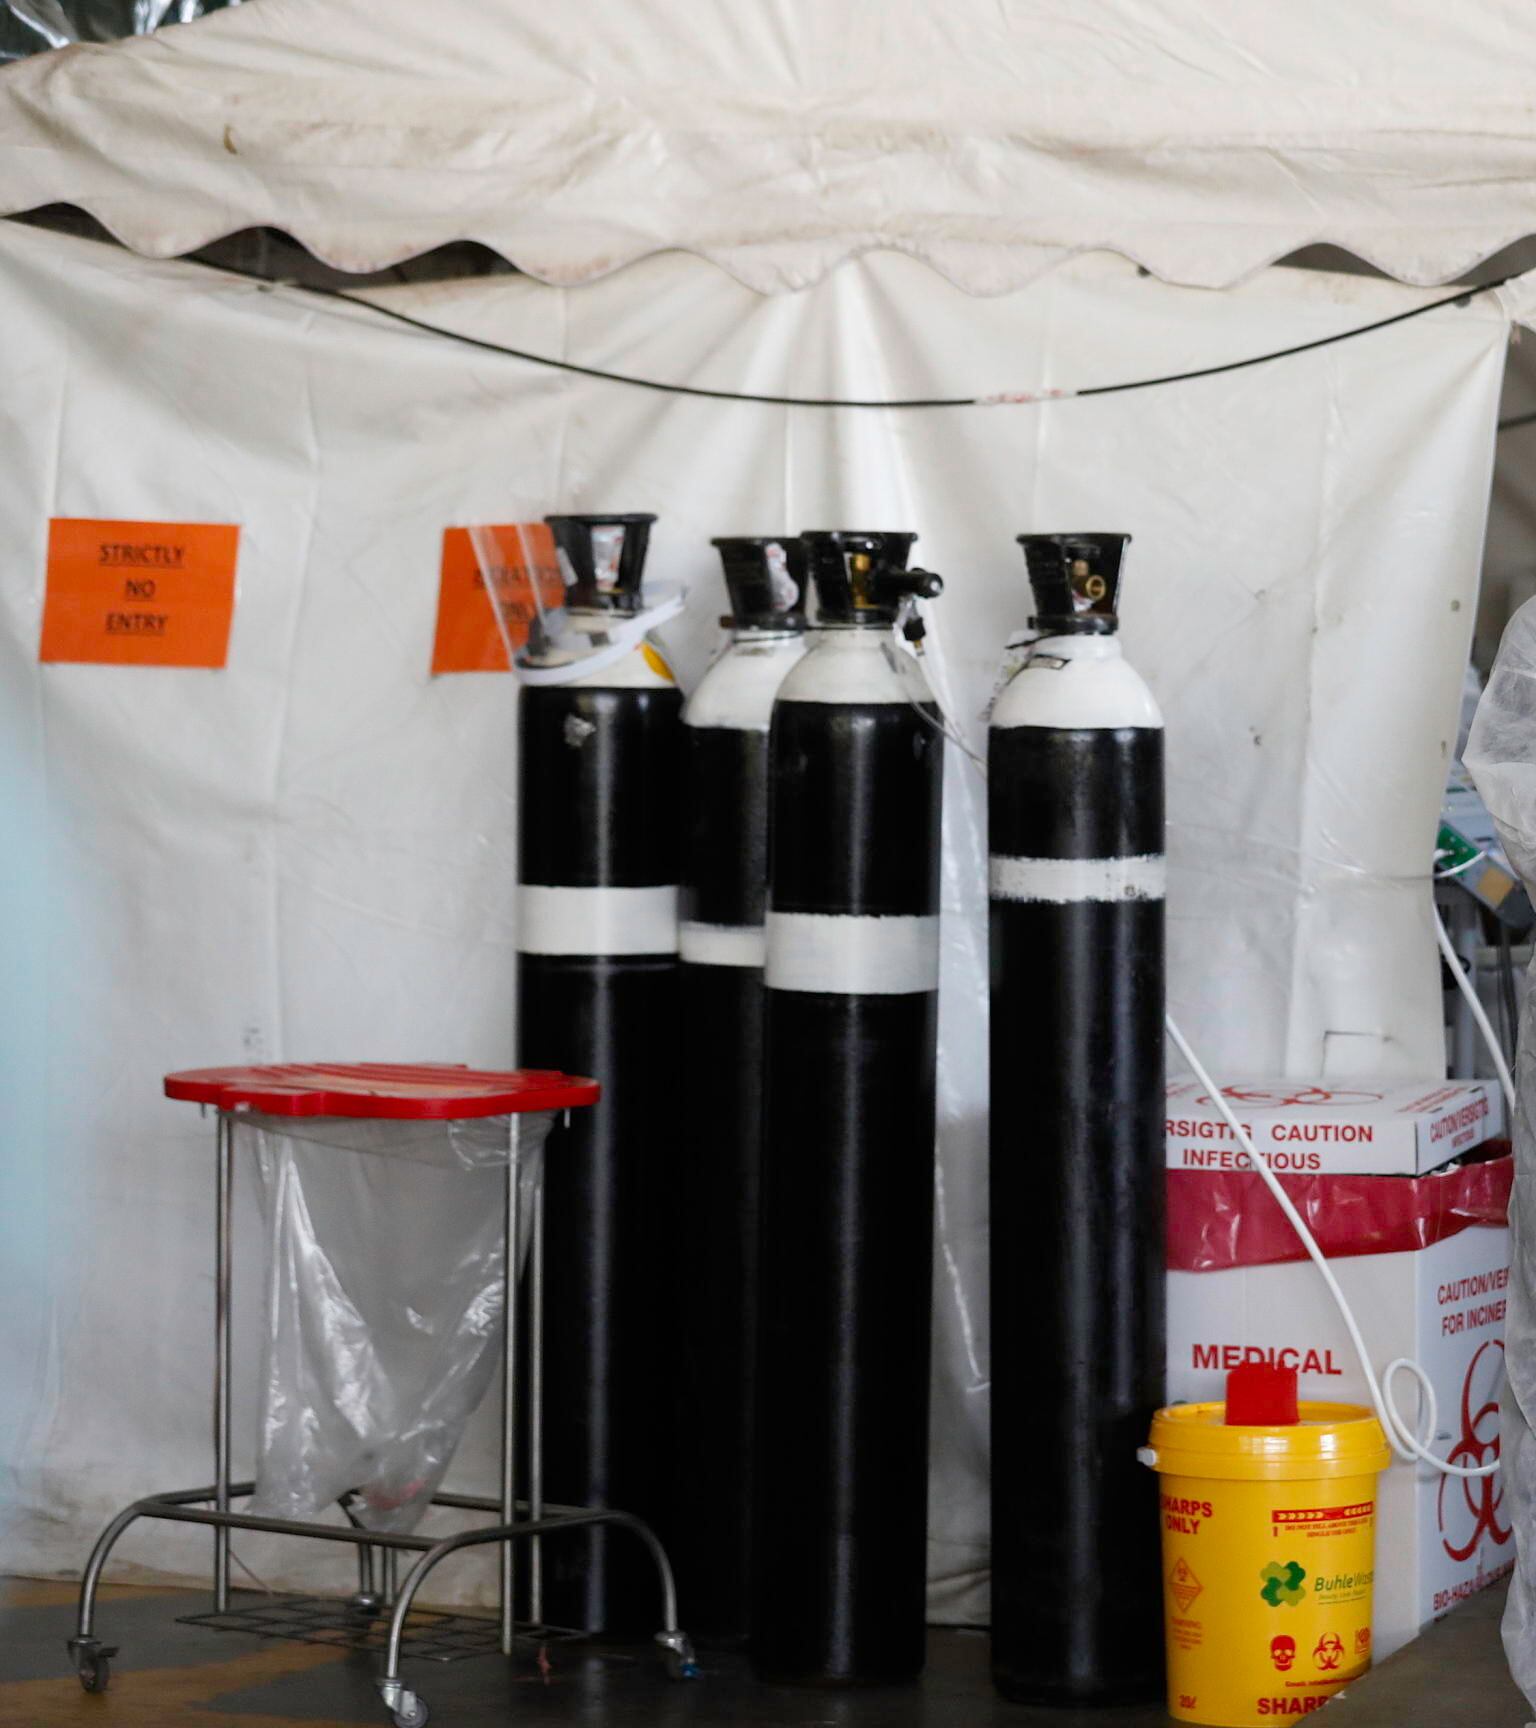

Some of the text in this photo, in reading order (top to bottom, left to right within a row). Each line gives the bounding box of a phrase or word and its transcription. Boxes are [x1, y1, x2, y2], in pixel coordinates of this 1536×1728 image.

[100, 545, 184, 567] STRICTLY
[125, 579, 156, 601] NO
[105, 612, 168, 636] ENTRY
[1271, 1124, 1374, 1143] CAUTION
[1183, 1148, 1321, 1170] INFECIOUS
[1442, 1312, 1464, 1337] FOR
[1192, 1343, 1343, 1376] MEDICAL
